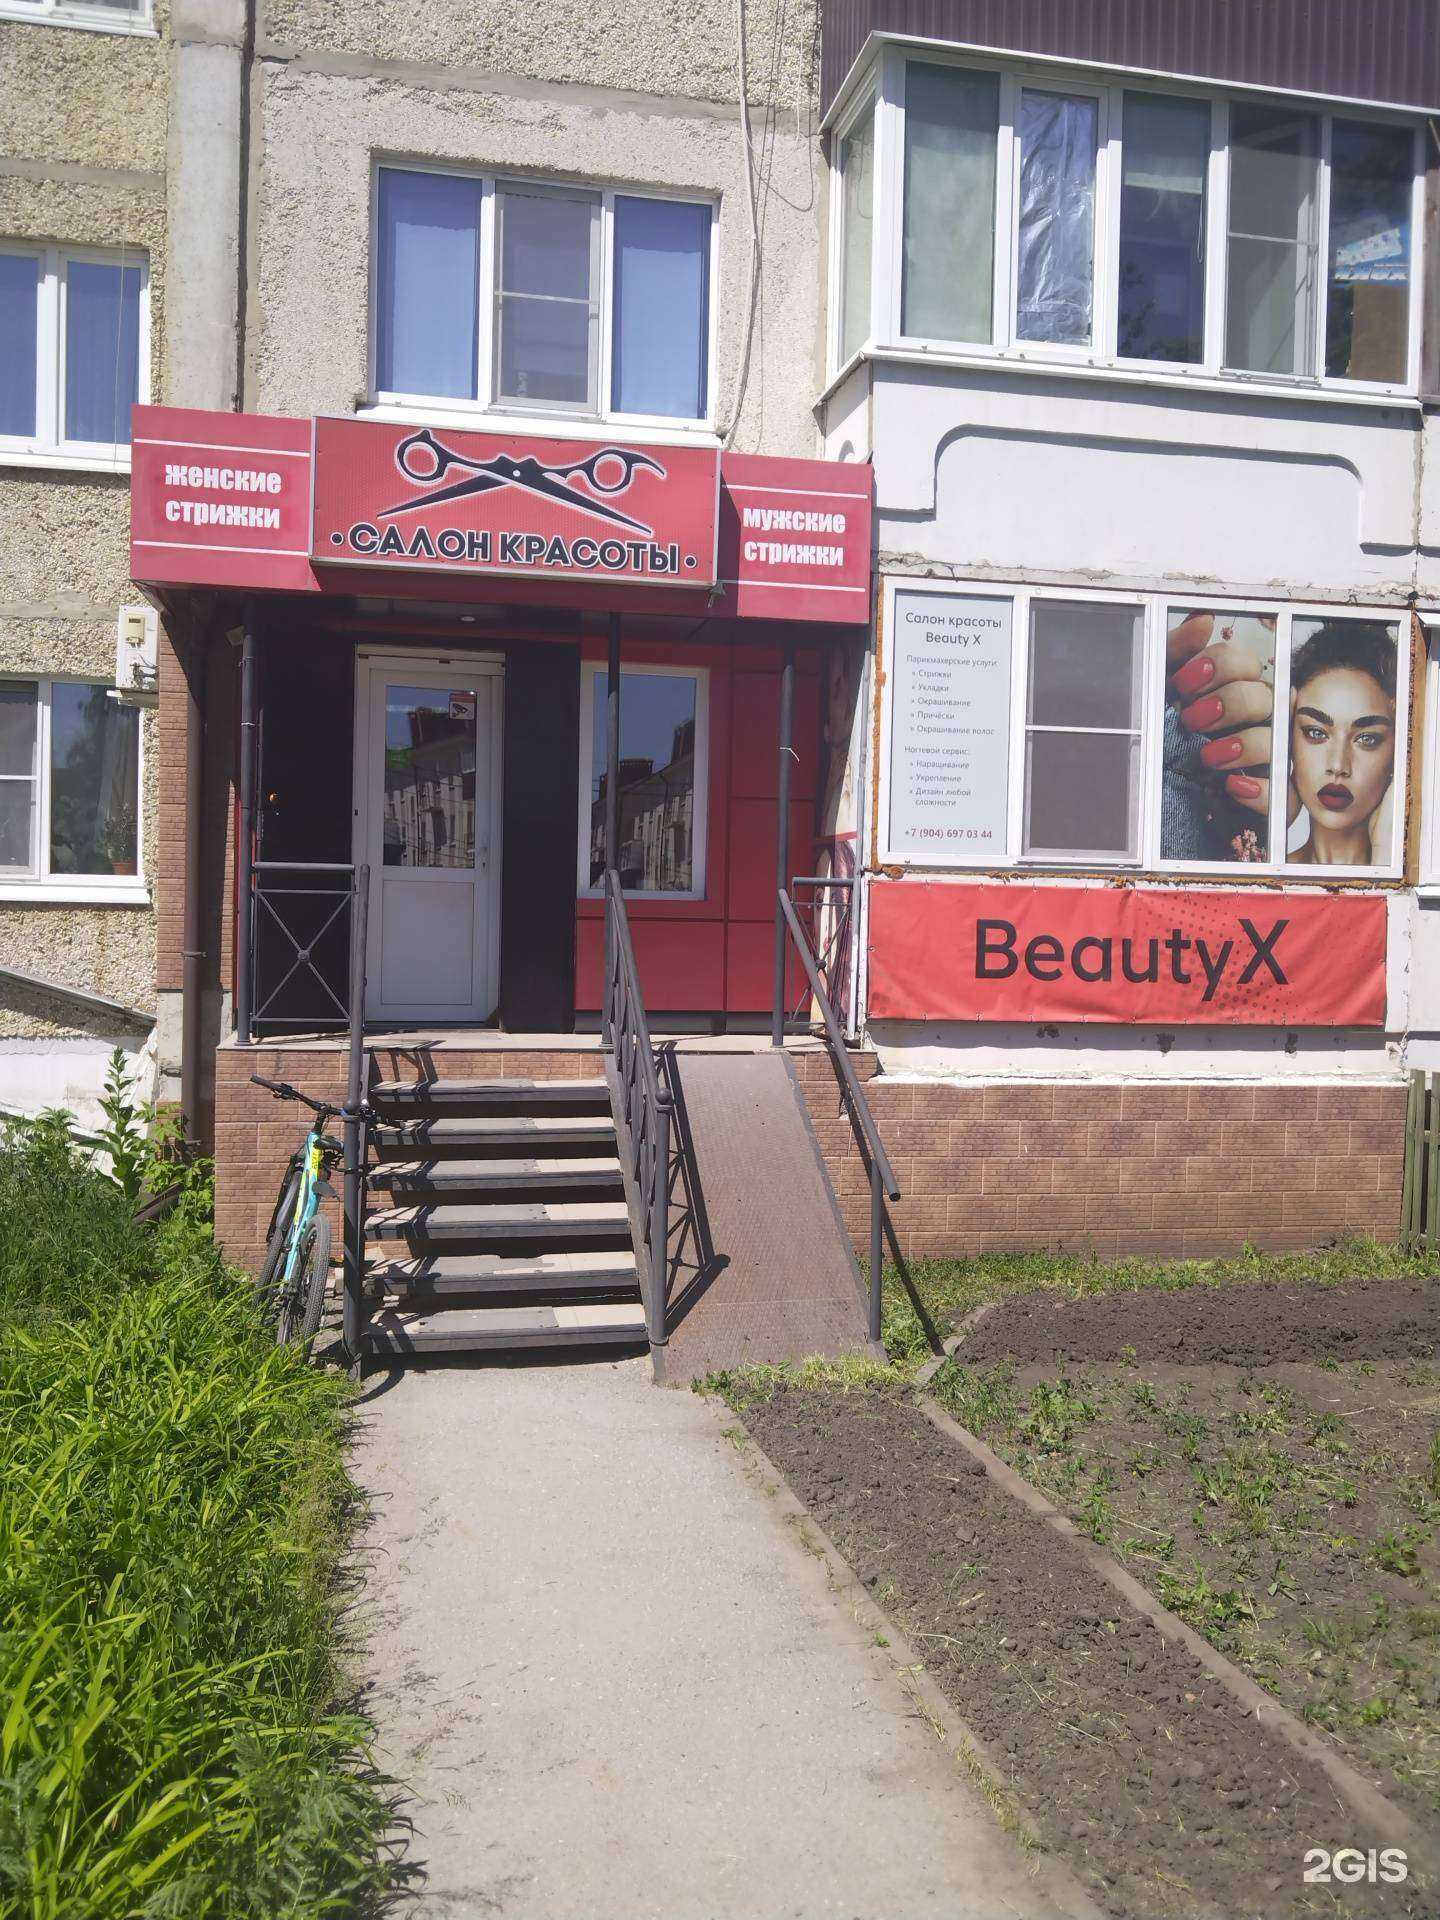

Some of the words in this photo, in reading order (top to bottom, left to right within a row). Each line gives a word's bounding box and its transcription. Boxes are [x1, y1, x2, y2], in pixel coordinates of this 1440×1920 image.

[165, 464, 282, 494] женские
[165, 500, 280, 529] стрижки
[743, 507, 846, 534] мужские
[348, 522, 492, 563] САЛОН
[499, 532, 681, 574] КРАСОТЫ
[744, 540, 844, 566] стрижки
[905, 612, 945, 625] Салон
[948, 617, 1002, 629] красоты
[926, 631, 970, 647] Beauty
[972, 633, 982, 646] X
[918, 683, 950, 693] Укладки
[917, 697, 971, 707] Окрашивание
[916, 725, 971, 735] Окрашивание
[916, 760, 970, 770] Наращивание
[916, 774, 962, 783] Укрепление
[915, 787, 944, 797] Дизайн
[920, 828, 944, 839] (904)
[946, 829, 965, 839] 697
[967, 830, 978, 839] 03
[981, 830, 993, 840] 44
[974, 918, 1290, 1001] BeautyX
